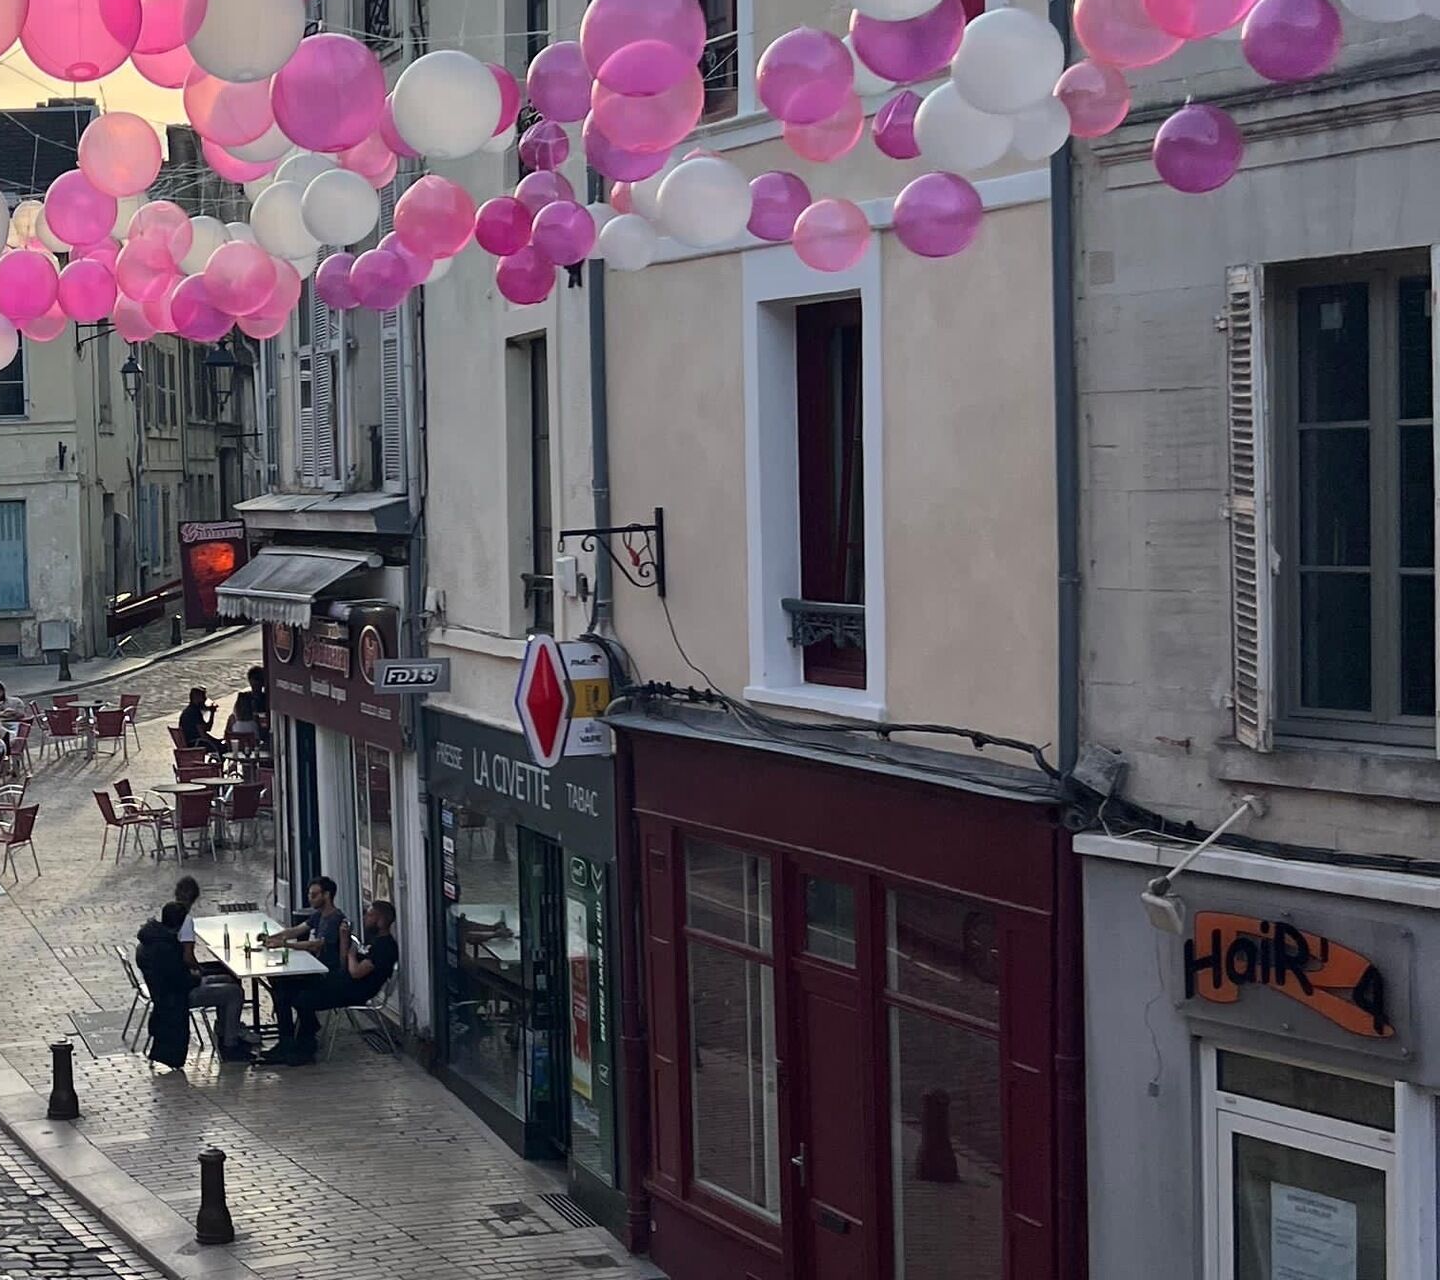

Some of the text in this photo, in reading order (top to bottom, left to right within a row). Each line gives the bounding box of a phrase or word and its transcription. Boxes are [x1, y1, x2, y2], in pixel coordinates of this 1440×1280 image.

[386, 668, 420, 684] FDJ
[435, 741, 464, 770] PRESSE
[473, 747, 552, 811] LA CIVETTE
[565, 782, 600, 818] TABAC
